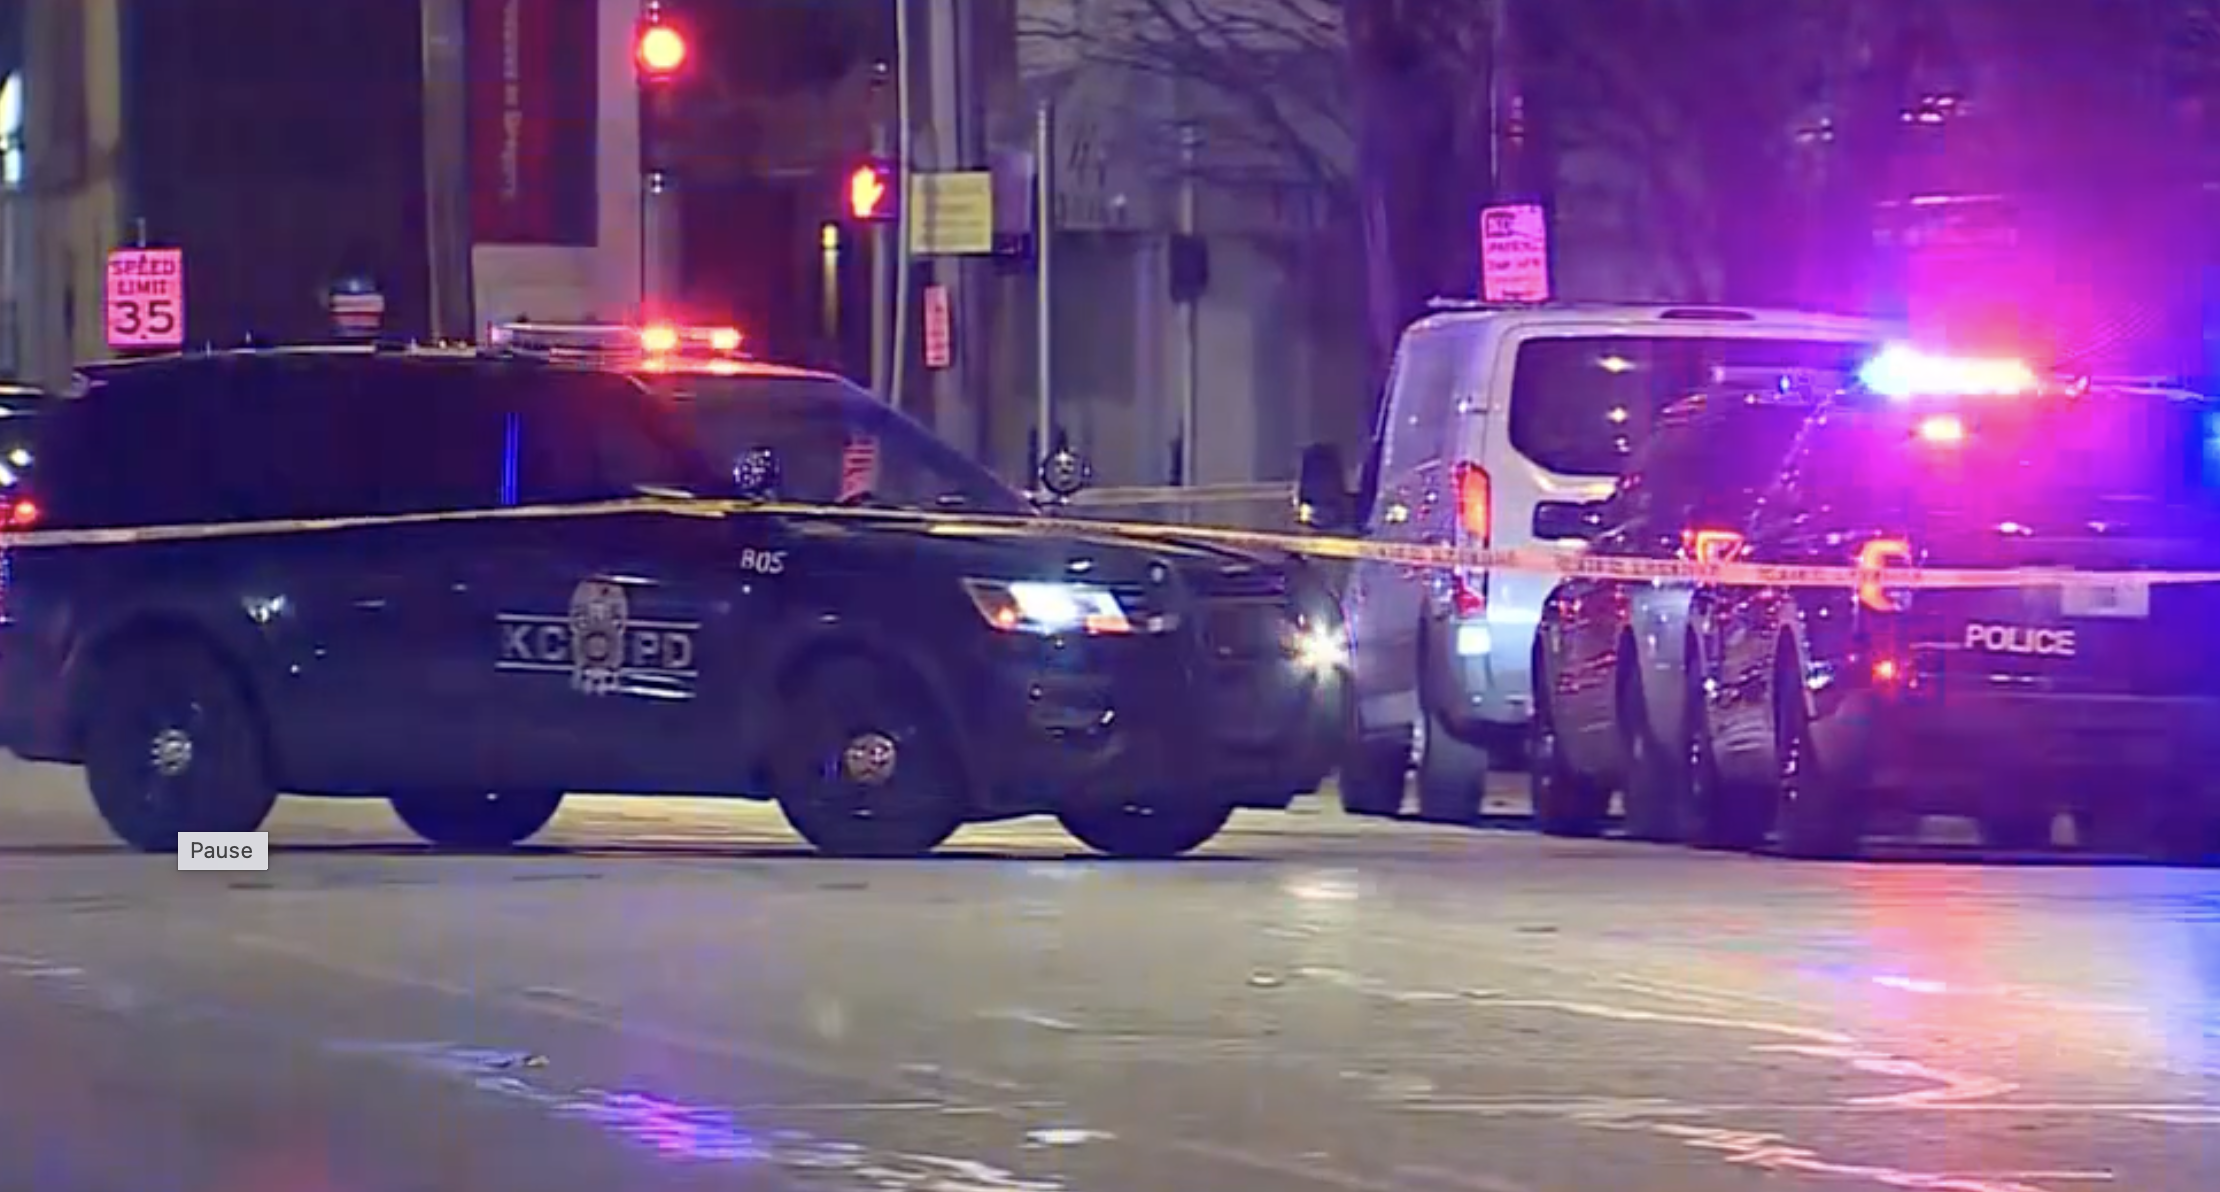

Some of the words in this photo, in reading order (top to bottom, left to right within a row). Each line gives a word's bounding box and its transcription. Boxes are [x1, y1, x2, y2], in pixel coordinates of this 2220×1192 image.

[112, 260, 175, 275] SPEED
[117, 280, 168, 295] LIMIT
[115, 300, 174, 335] 35
[740, 548, 788, 574] 805
[1964, 623, 2076, 655] POLICE
